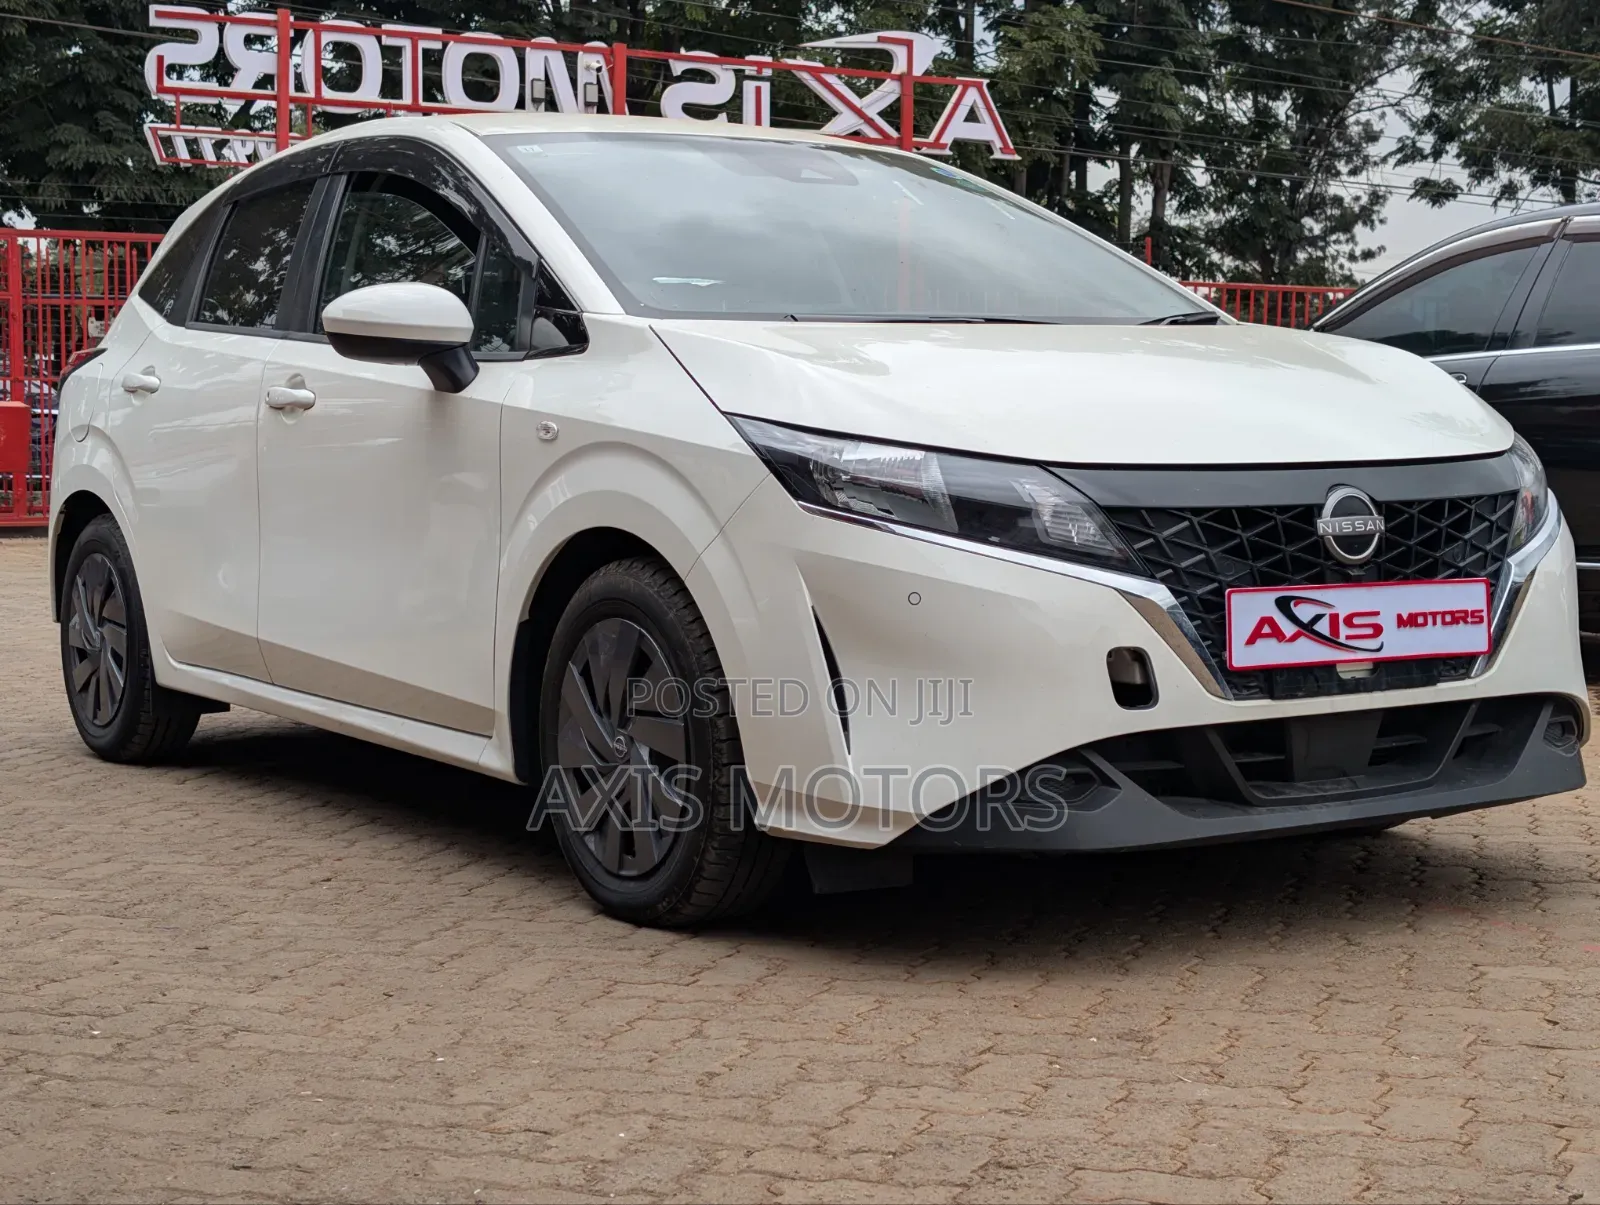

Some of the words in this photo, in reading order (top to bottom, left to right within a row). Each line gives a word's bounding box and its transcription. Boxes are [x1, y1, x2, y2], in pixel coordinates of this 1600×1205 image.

[1319, 519, 1385, 534] NISSAN
[1244, 597, 1384, 652] AXIS
[1396, 609, 1485, 630] MOTORS
